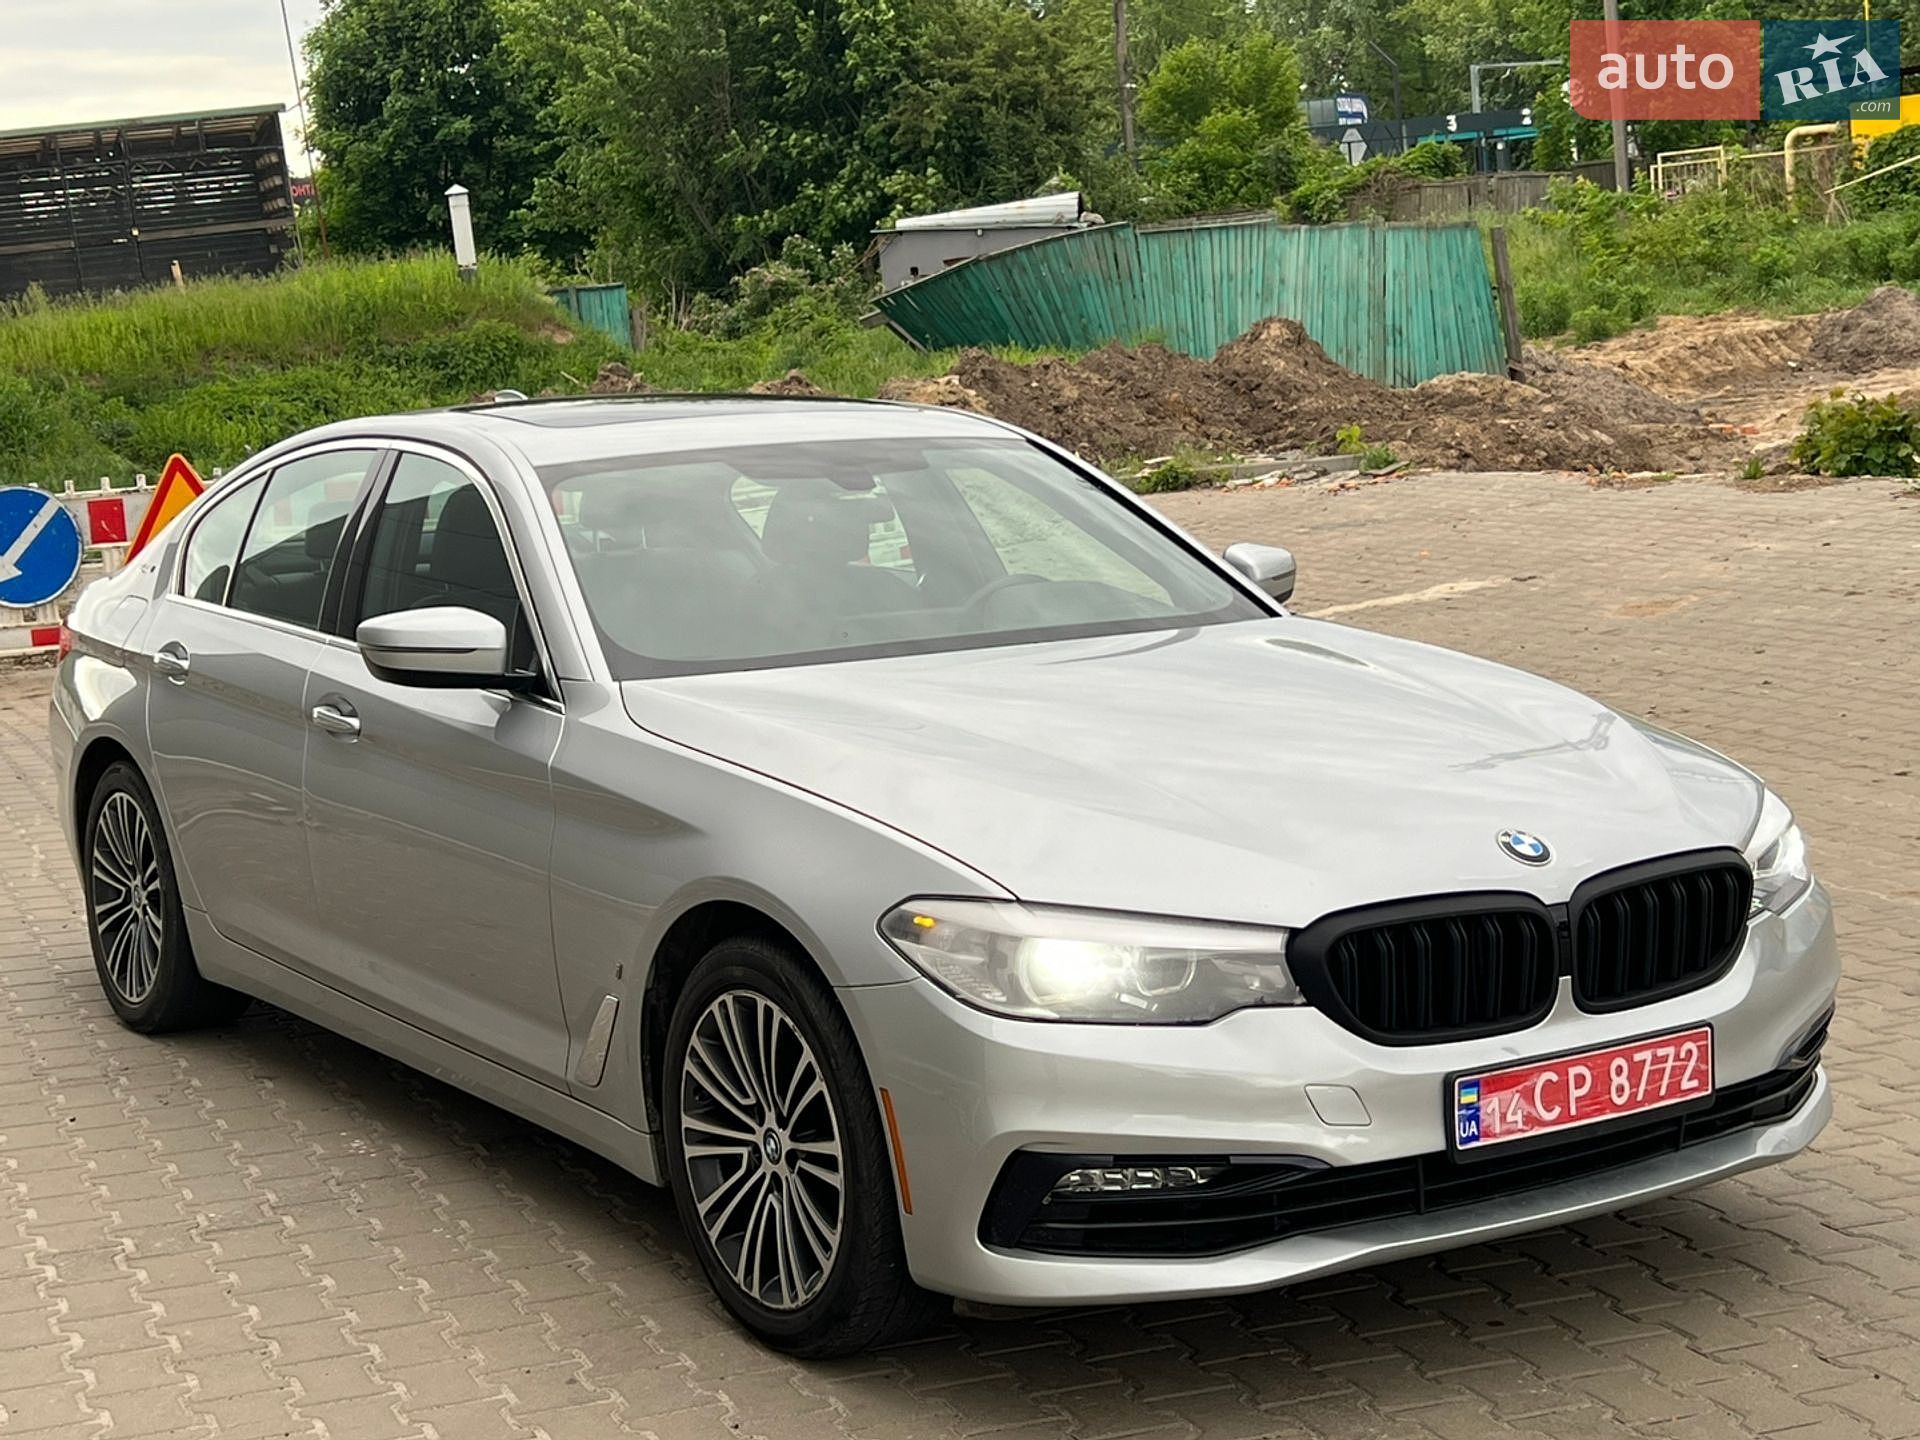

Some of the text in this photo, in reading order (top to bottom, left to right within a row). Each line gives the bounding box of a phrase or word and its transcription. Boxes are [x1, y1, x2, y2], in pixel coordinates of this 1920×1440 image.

[1446, 114, 1457, 132] 3
[1609, 1041, 1699, 1105] 8772
[1460, 1119, 1479, 1138] UA
